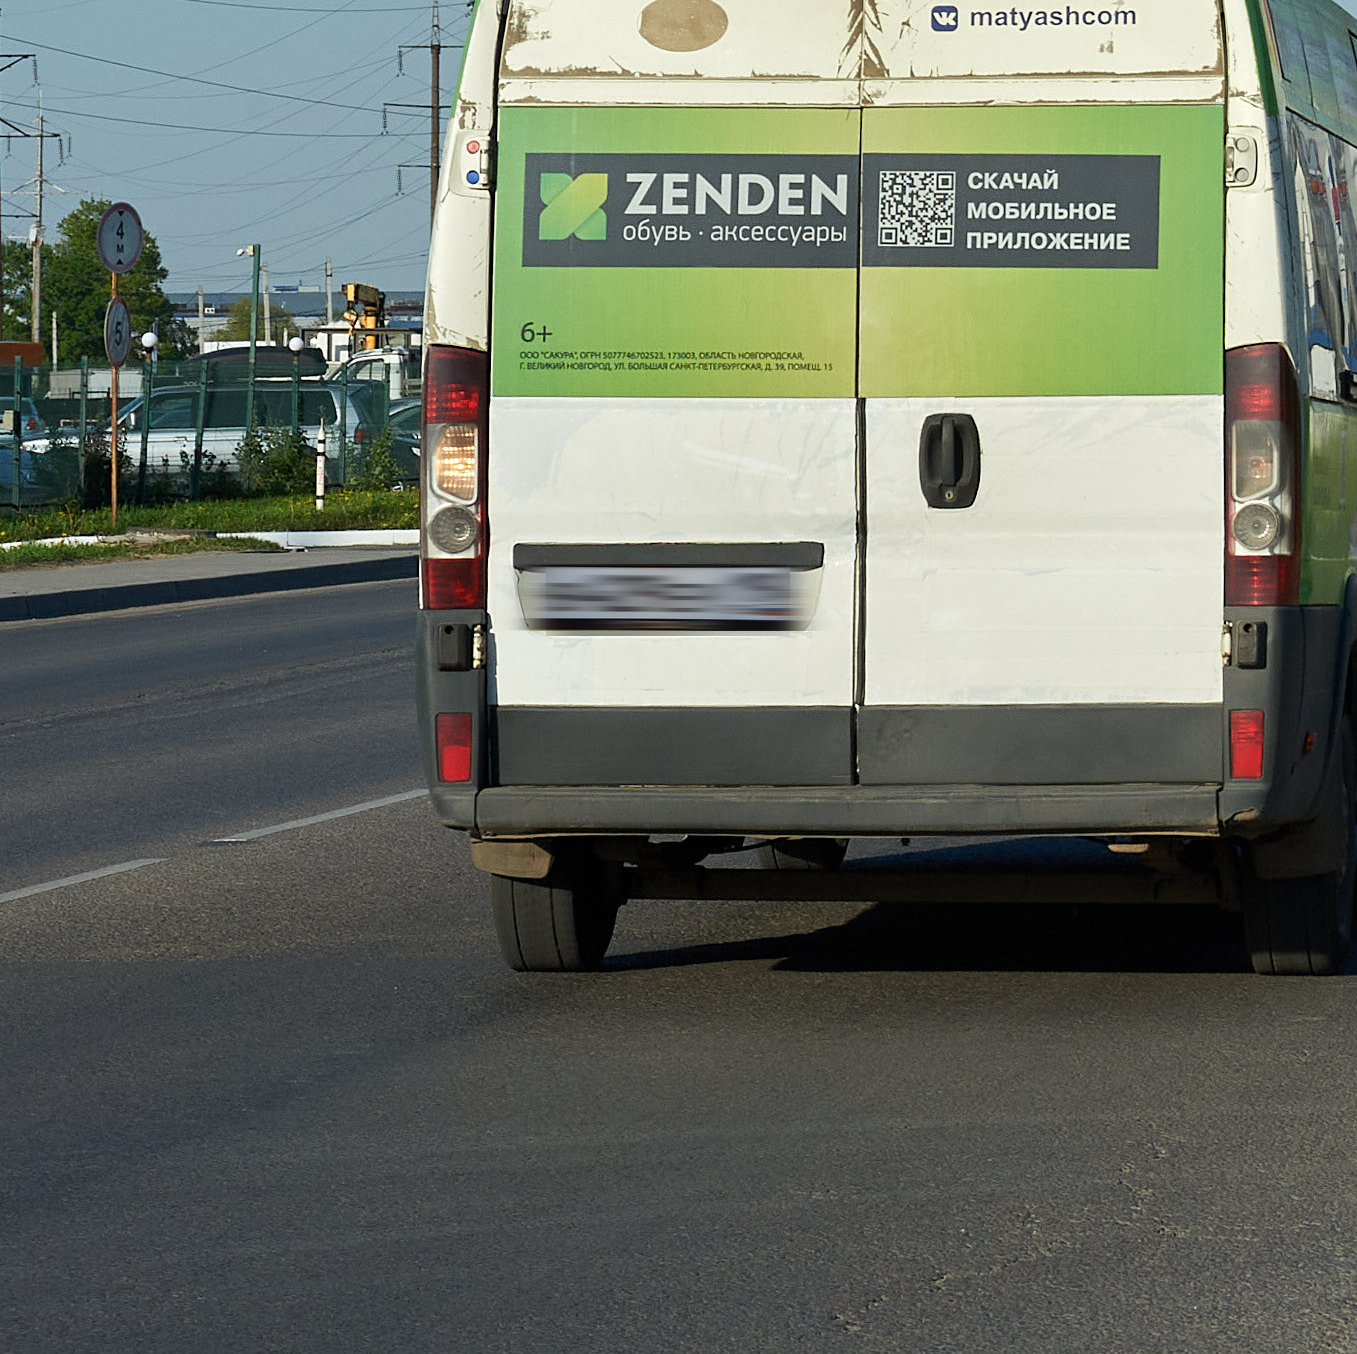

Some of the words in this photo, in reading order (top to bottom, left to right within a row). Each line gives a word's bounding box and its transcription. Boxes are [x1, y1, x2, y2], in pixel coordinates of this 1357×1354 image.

[970, 5, 1137, 32] matyashcom
[966, 168, 1059, 190] СКАЧАЙ
[624, 172, 848, 216] ZENDEN
[966, 201, 1117, 221] МОБИЛЬНОЕ
[116, 221, 125, 240] 4
[622, 218, 692, 247] обувь
[710, 224, 847, 247] аксессуары
[966, 231, 1131, 251] ПРИЛОЖЕНИЕ
[115, 322, 122, 346] 5
[520, 321, 553, 343] 6+
[519, 351, 540, 359] ООО
[580, 351, 601, 359] ОГРН
[699, 351, 737, 359] ОБЛАСТЬ
[738, 351, 805, 361] НОВГОРОДСКАЯ,
[527, 360, 566, 370] ВЕЛИКИЙ
[628, 362, 668, 370] БОЛЬШАЯ
[824, 362, 833, 371] 15
